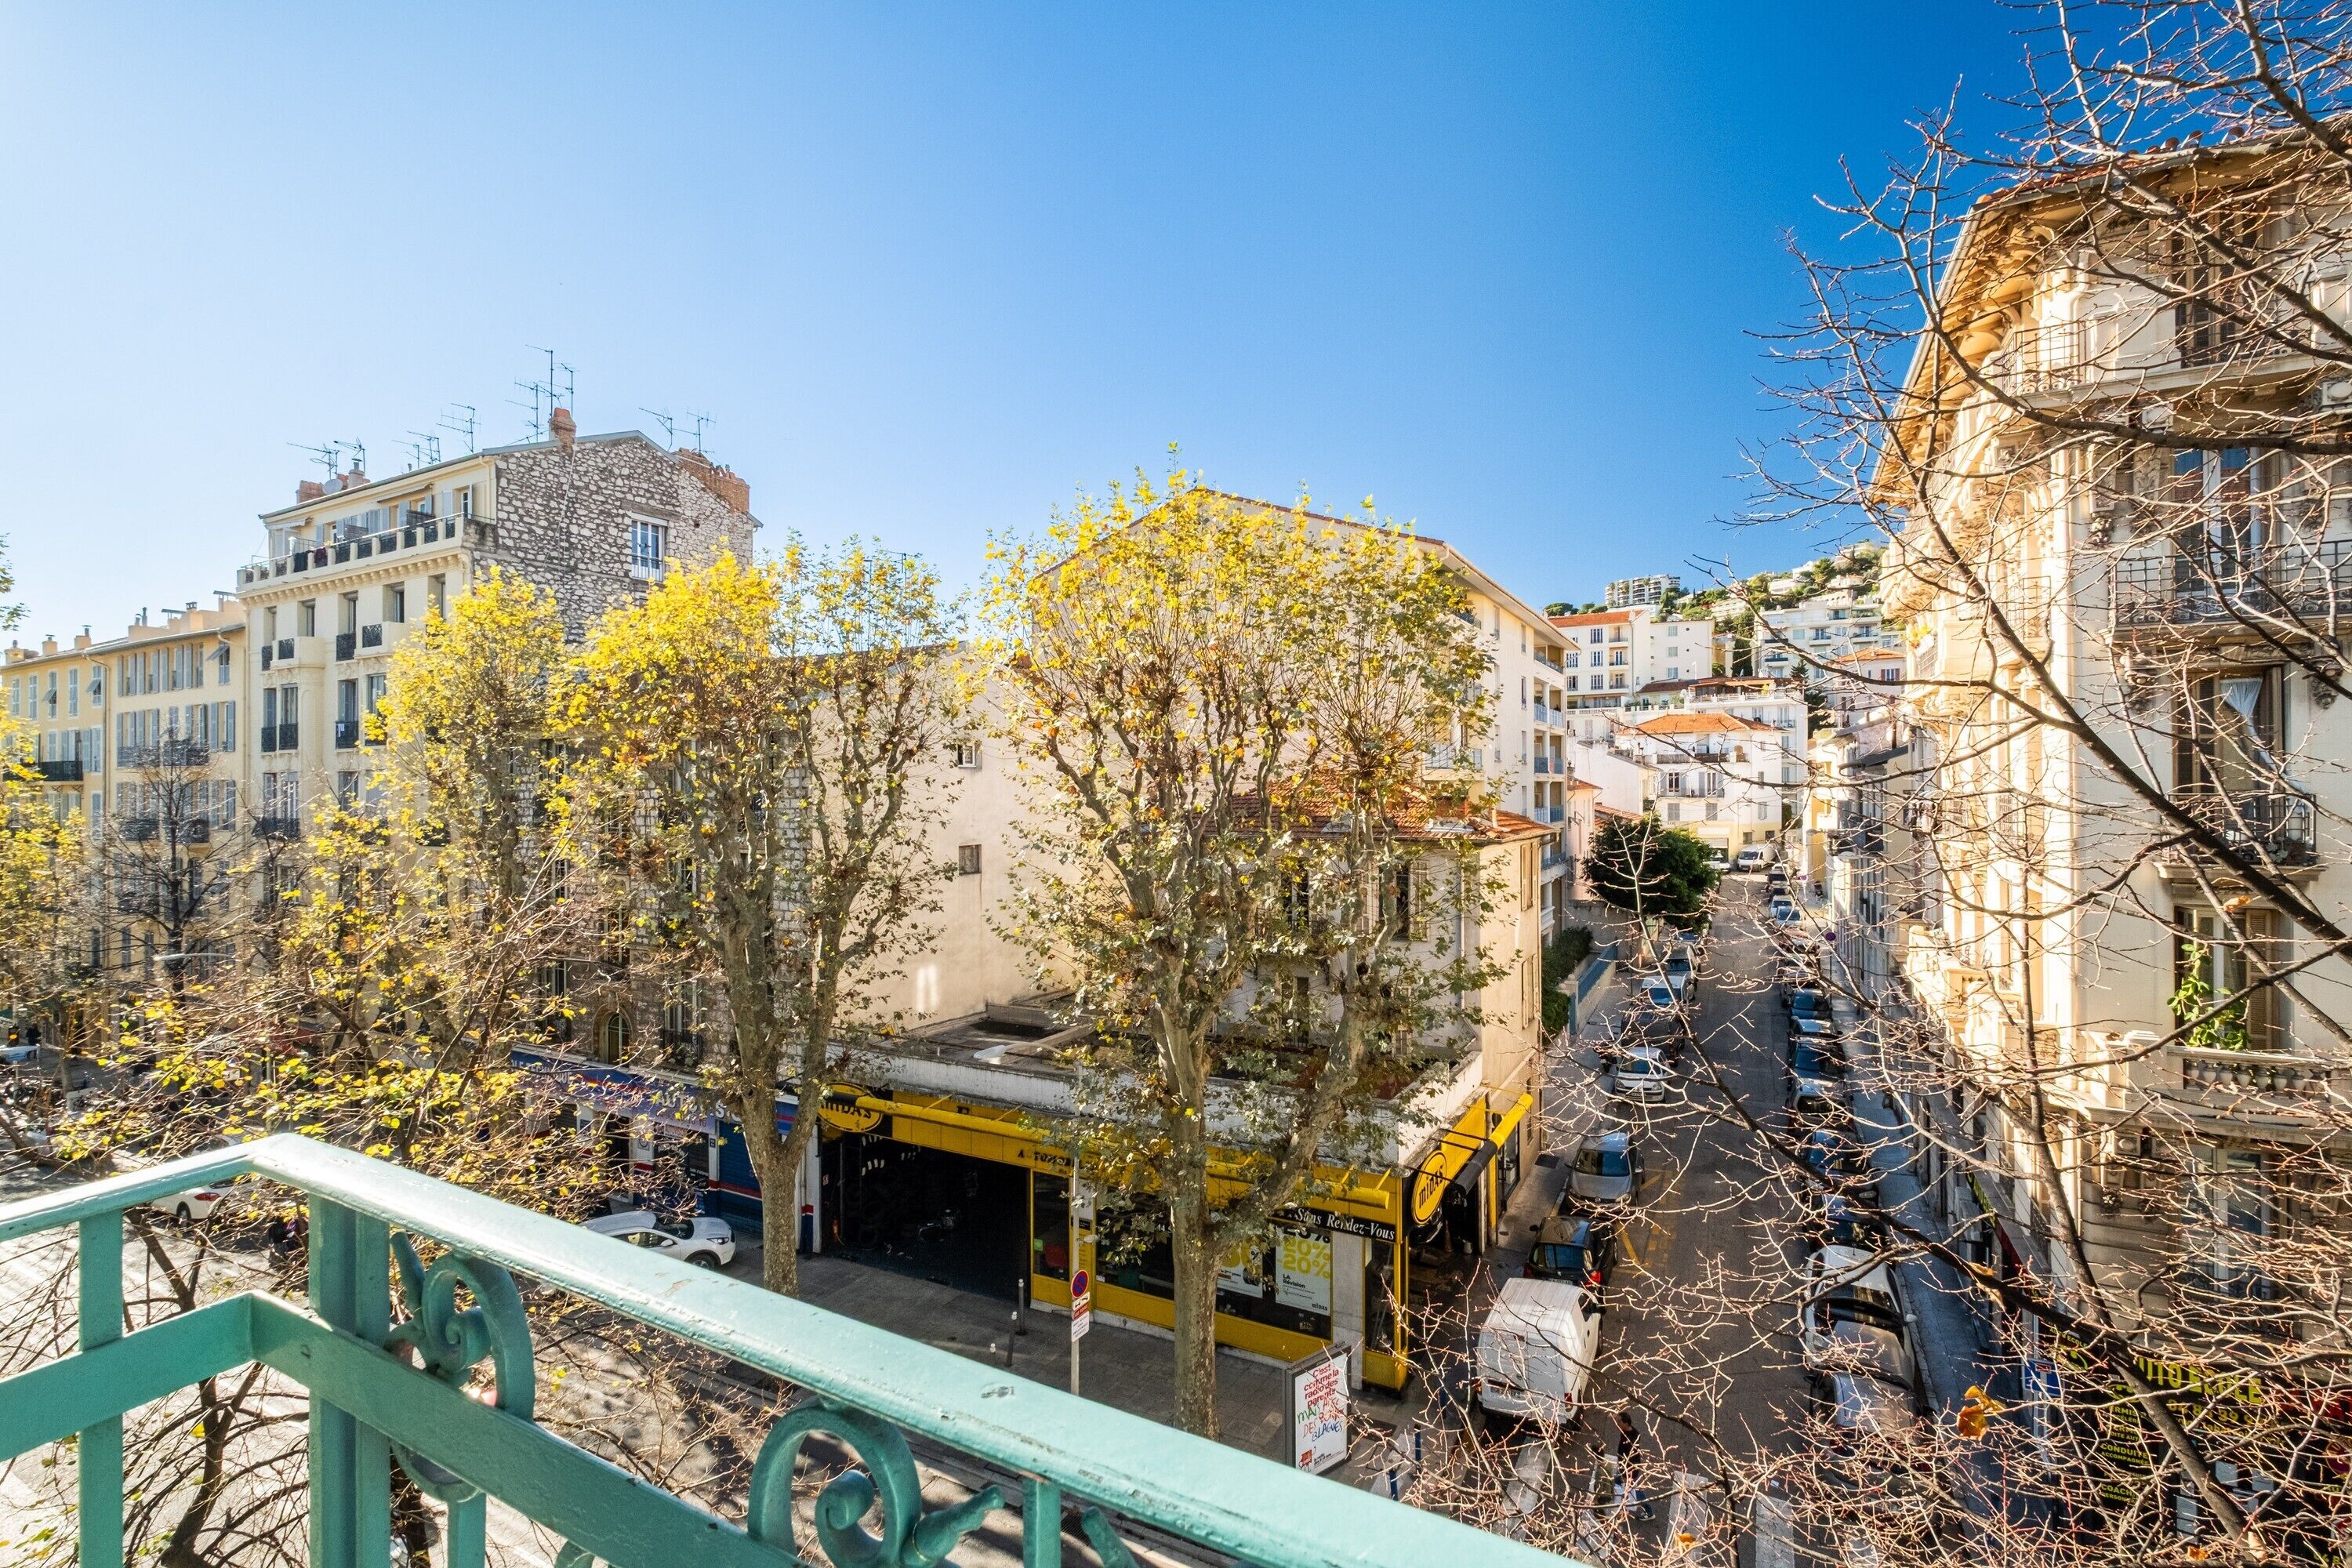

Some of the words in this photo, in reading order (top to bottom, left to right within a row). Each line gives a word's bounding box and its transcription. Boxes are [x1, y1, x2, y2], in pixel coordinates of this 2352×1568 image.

[1297, 1207, 1322, 1225] Sans
[1327, 1213, 1396, 1240] Rendez-Vous
[1283, 1279, 1306, 1289] Révision
[1313, 1363, 1331, 1378] C'est
[1305, 1385, 1324, 1400] radio
[1307, 1388, 1336, 1410] parents
[2100, 1443, 2149, 1459] CONDUITE
